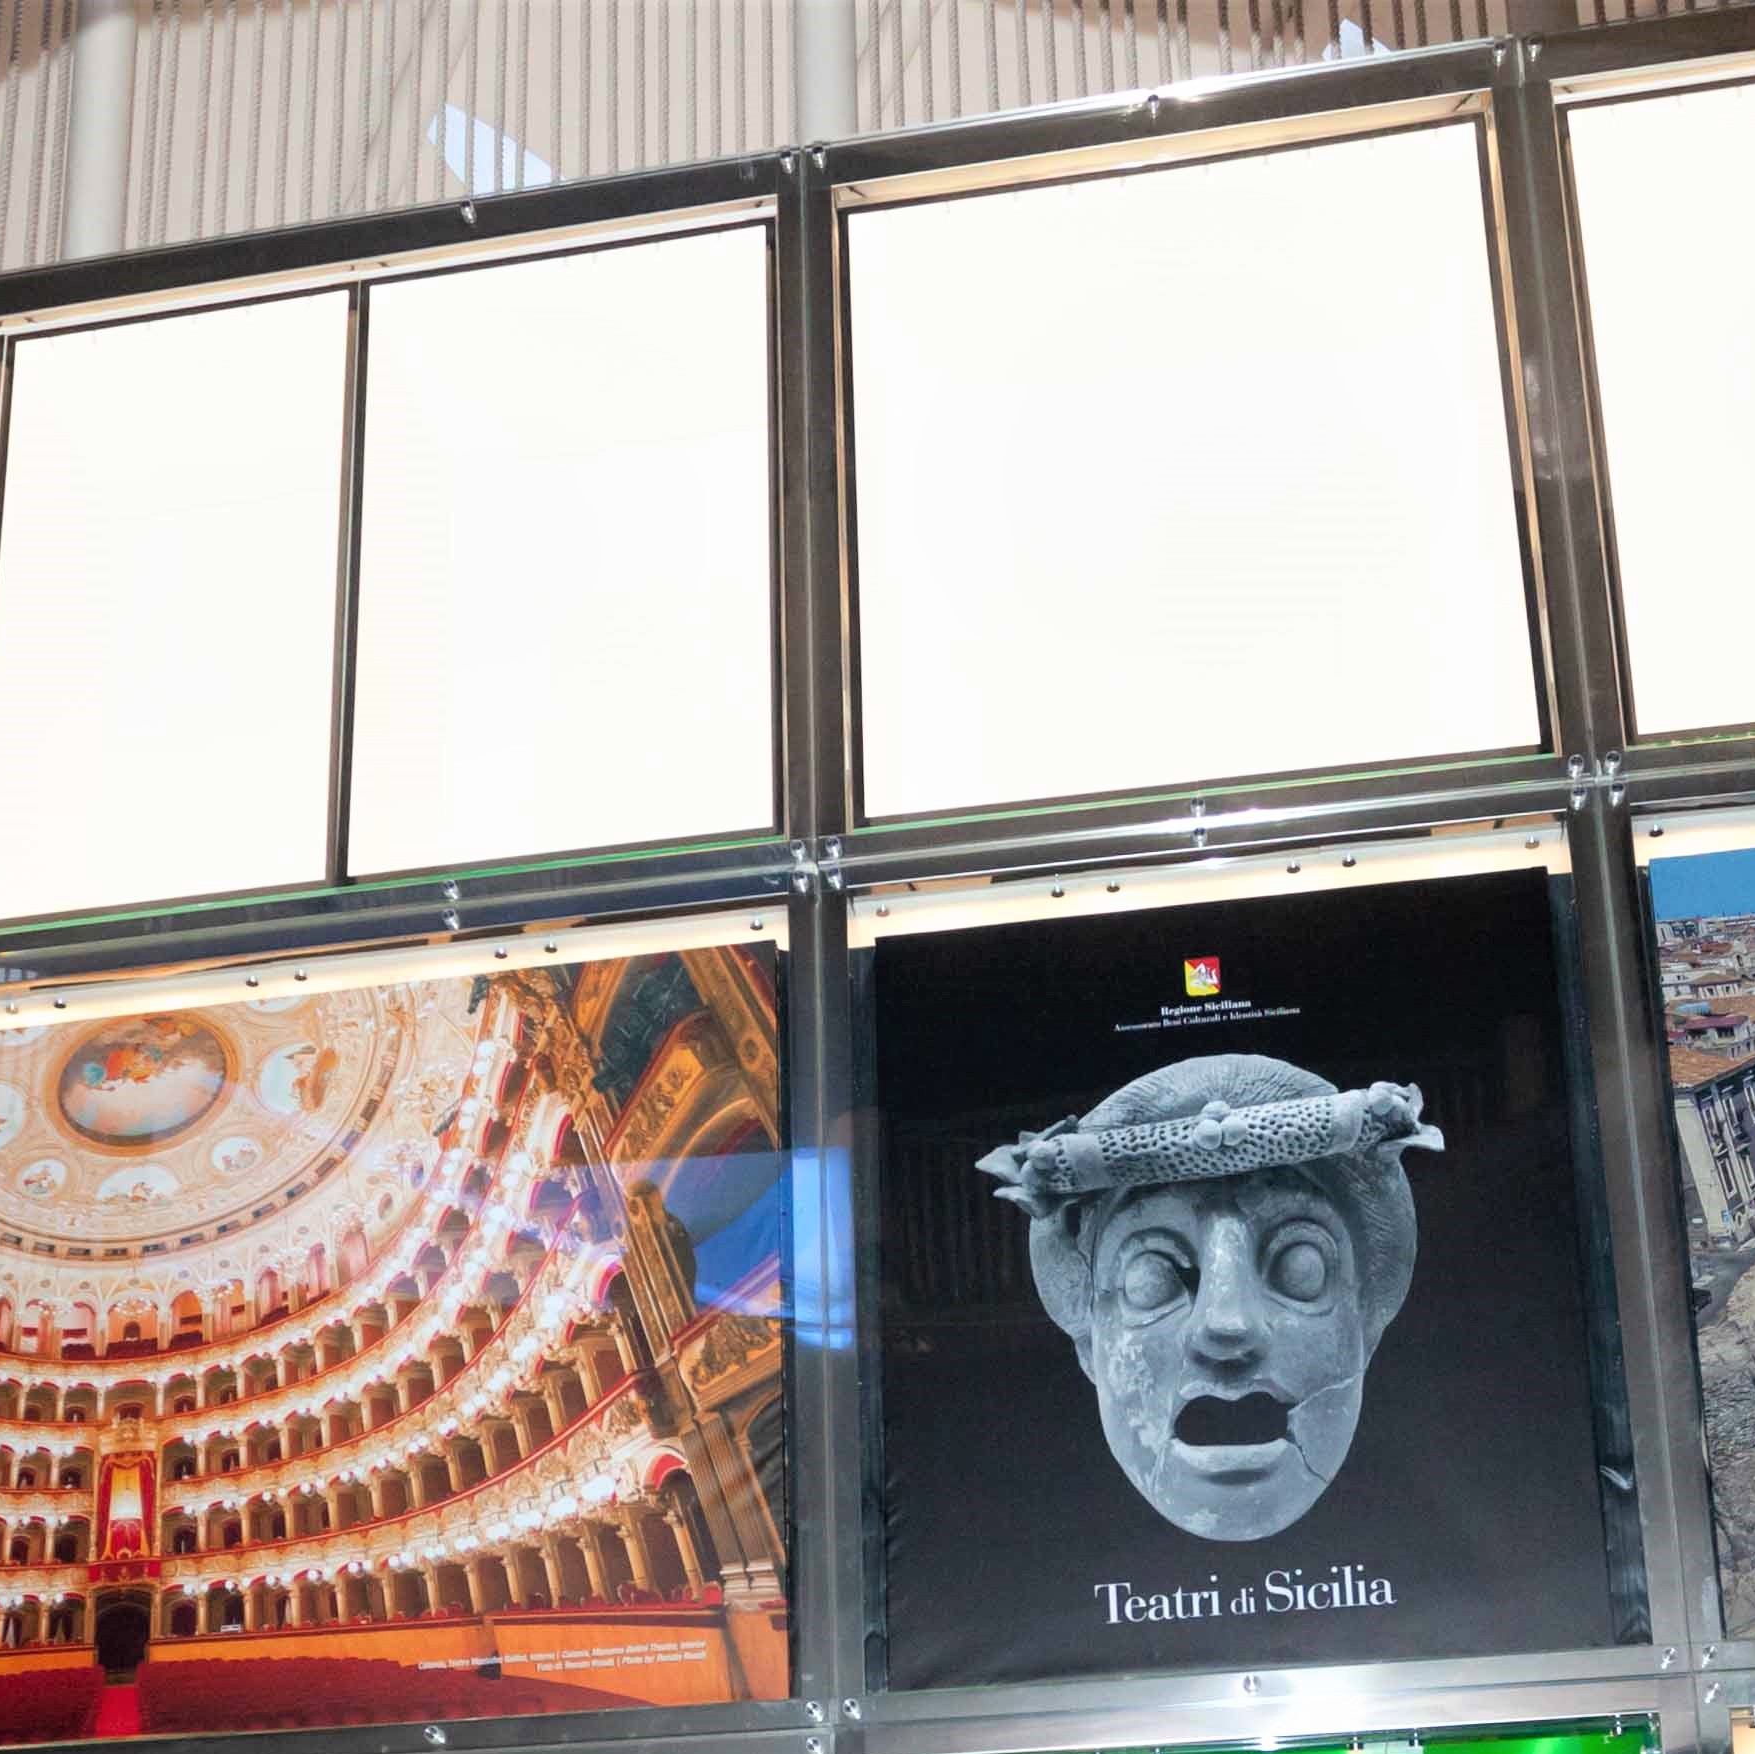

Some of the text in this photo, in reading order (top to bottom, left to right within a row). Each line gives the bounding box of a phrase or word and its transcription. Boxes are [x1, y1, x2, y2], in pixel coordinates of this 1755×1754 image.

[1160, 999, 1252, 1017] Regione Siciliana
[1162, 1017, 1182, 1028] Beni
[1183, 1013, 1221, 1025] Culturali
[1094, 1563, 1398, 1625] Teatri di Sicilia
